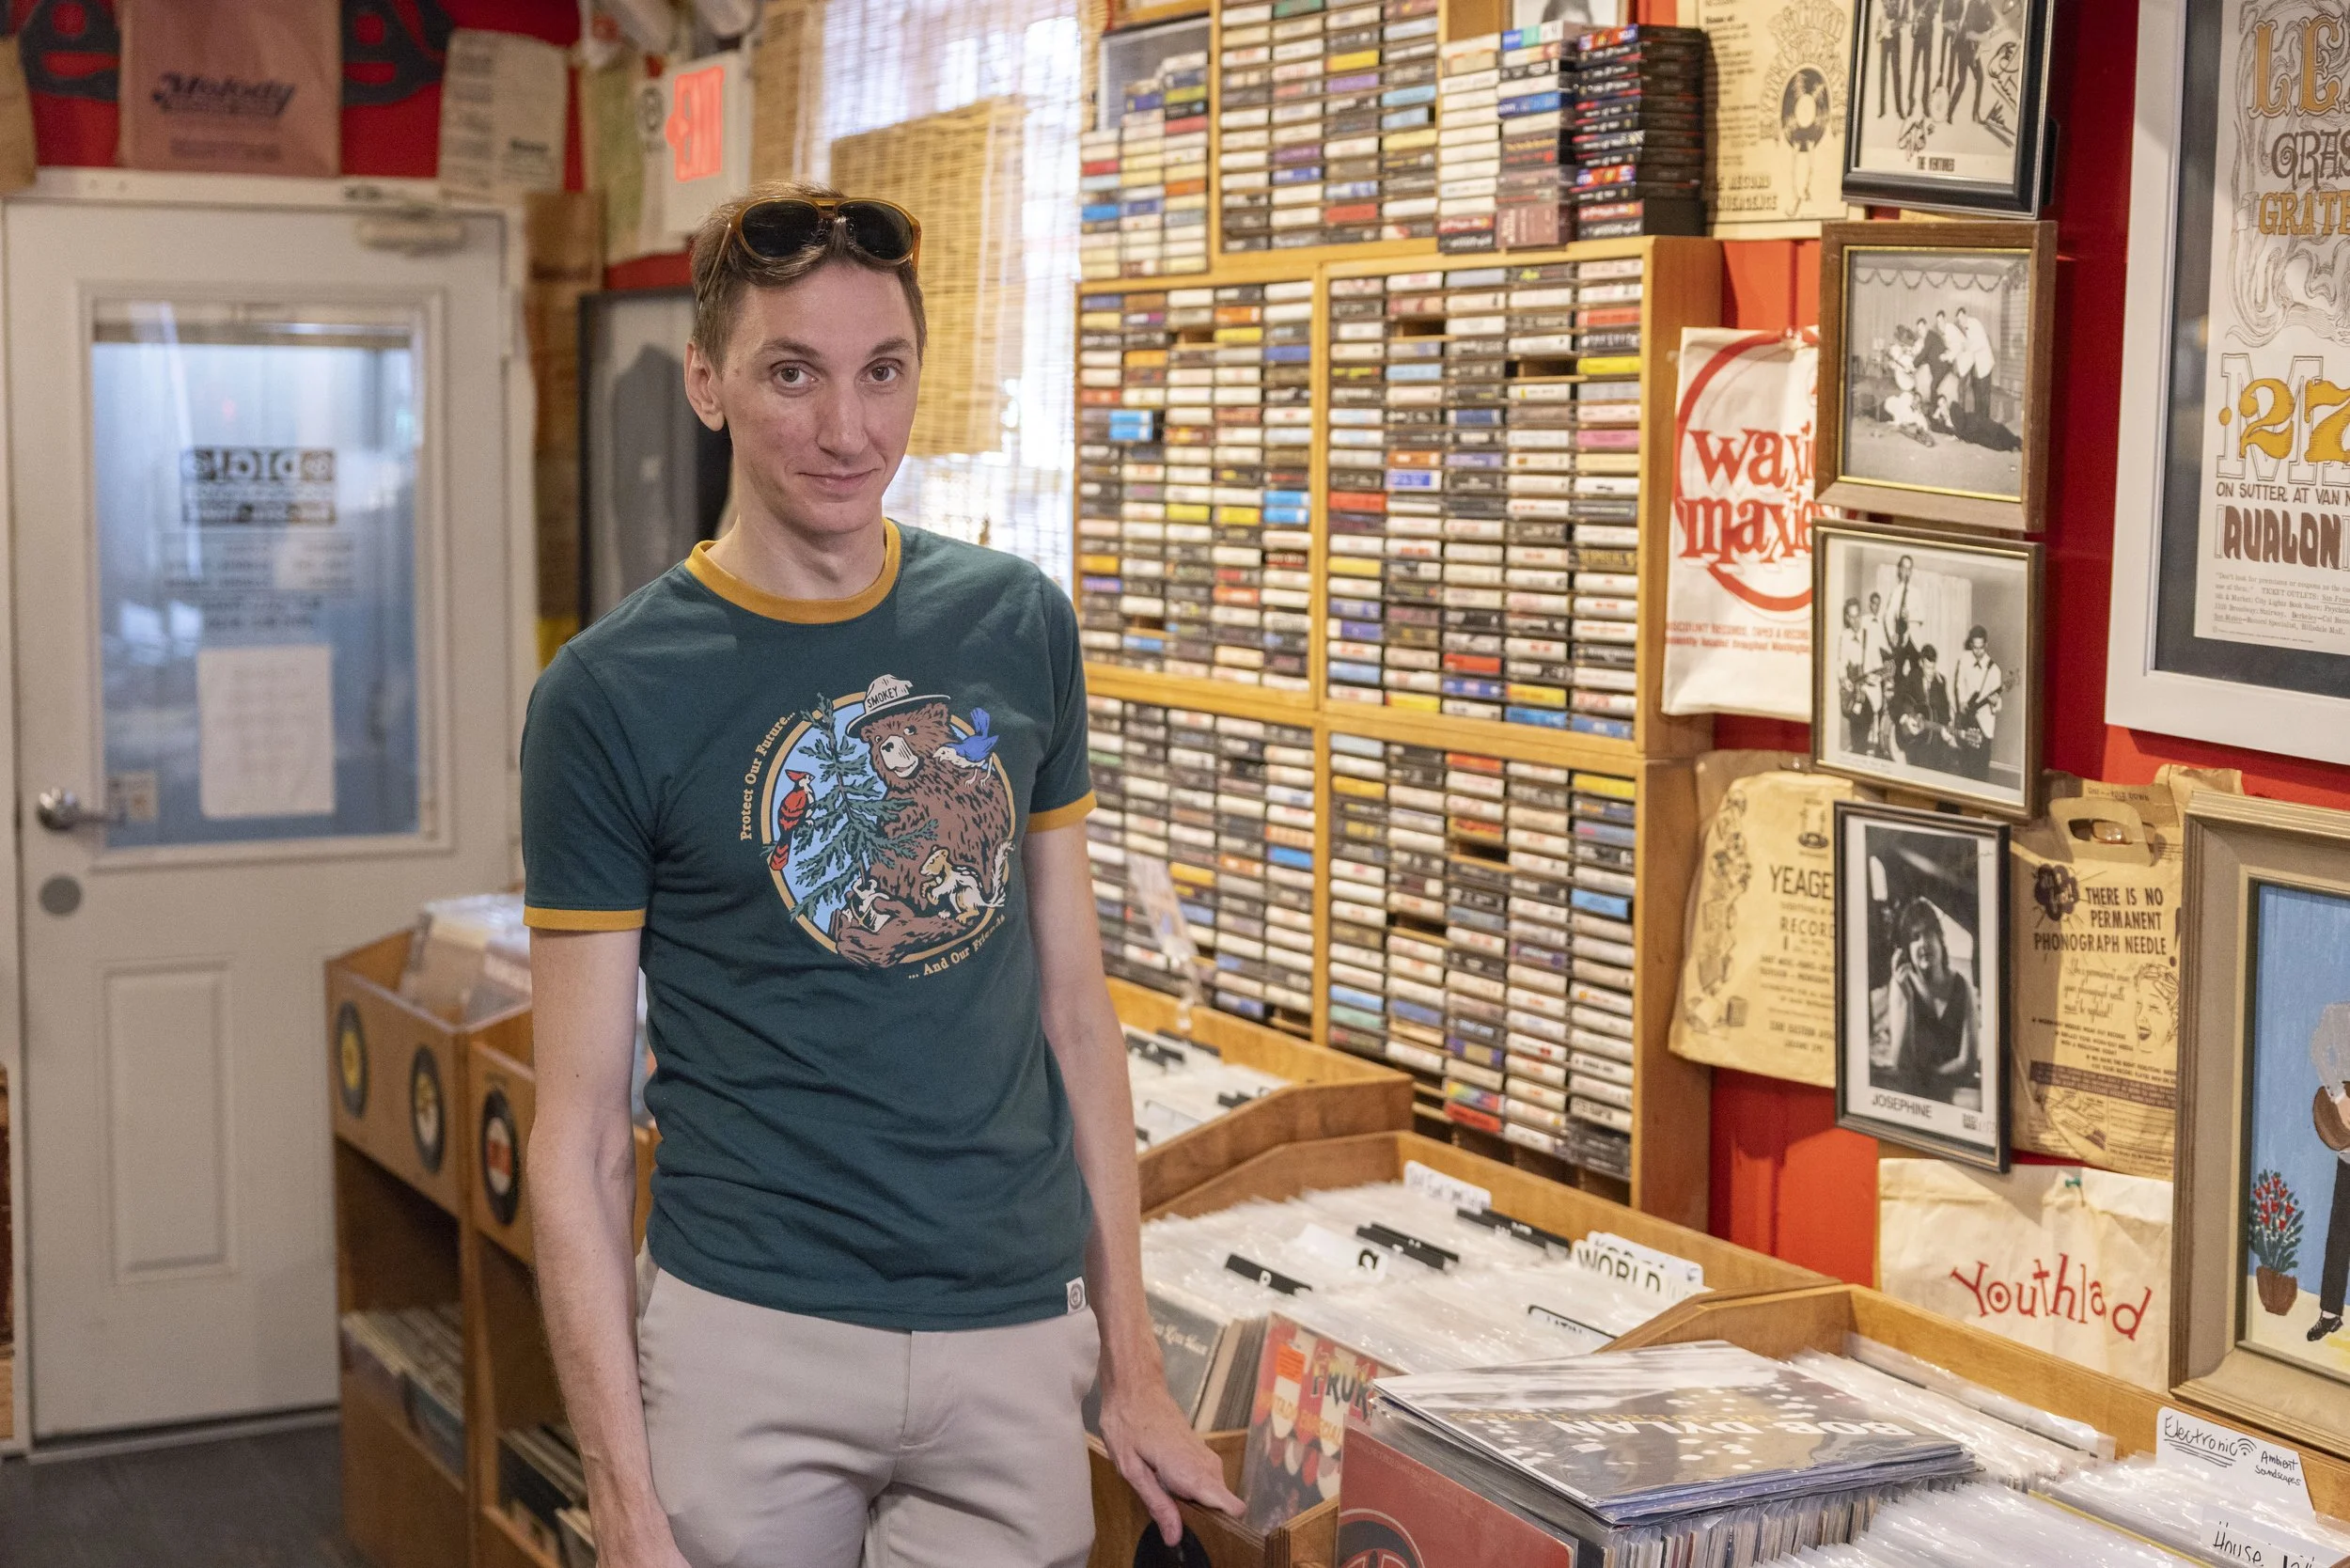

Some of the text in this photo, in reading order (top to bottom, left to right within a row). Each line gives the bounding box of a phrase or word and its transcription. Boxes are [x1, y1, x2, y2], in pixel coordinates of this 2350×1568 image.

[2248, 13, 2350, 119] LE
[1929, 157, 1955, 172] VENTURES
[1685, 420, 1816, 494] waxi
[2216, 482, 2234, 497] ON
[2240, 484, 2288, 502] SUTTER
[2293, 488, 2310, 504] AT
[2315, 489, 2340, 506] VAN
[2262, 588, 2284, 597] TICKET
[867, 686, 899, 709] SMOKEY
[744, 758, 762, 785] Our
[740, 788, 755, 841] Protect
[2086, 886, 2164, 906] THERE IS NO
[2090, 909, 2162, 931] PERMANENT
[923, 957, 949, 977] And
[950, 947, 971, 964] Our
[972, 914, 1006, 952] Friends
[2033, 932, 2167, 956] PHONOGRAPH NEEDLE
[1872, 1092, 1934, 1119] JOSEPHINE
[1949, 1252, 2154, 1342] Youthlad
[1548, 1420, 1917, 1436] BOB DYLAN
[2164, 1415, 2239, 1456] Electronic
[2261, 1450, 2299, 1471] Ambient
